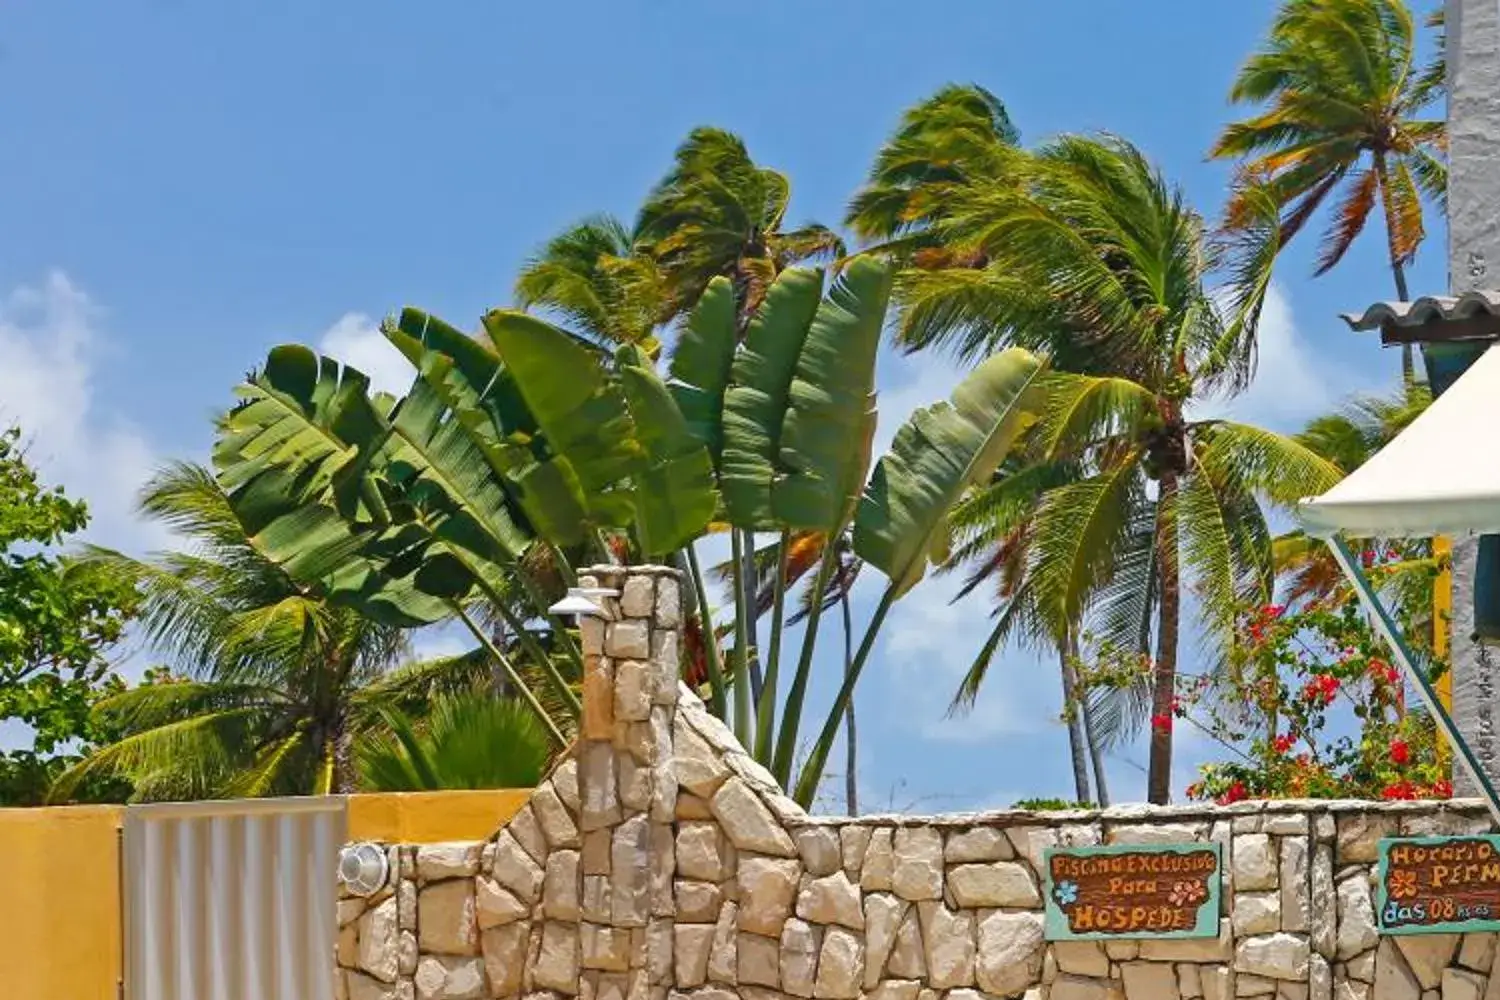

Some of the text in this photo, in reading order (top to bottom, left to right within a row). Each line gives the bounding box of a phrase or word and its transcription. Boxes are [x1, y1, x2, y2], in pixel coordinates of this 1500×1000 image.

[1109, 877, 1157, 895] Para
[1074, 903, 1185, 929] HOSPEDE
[1384, 902, 1425, 922] das
[1430, 898, 1454, 919] 08
